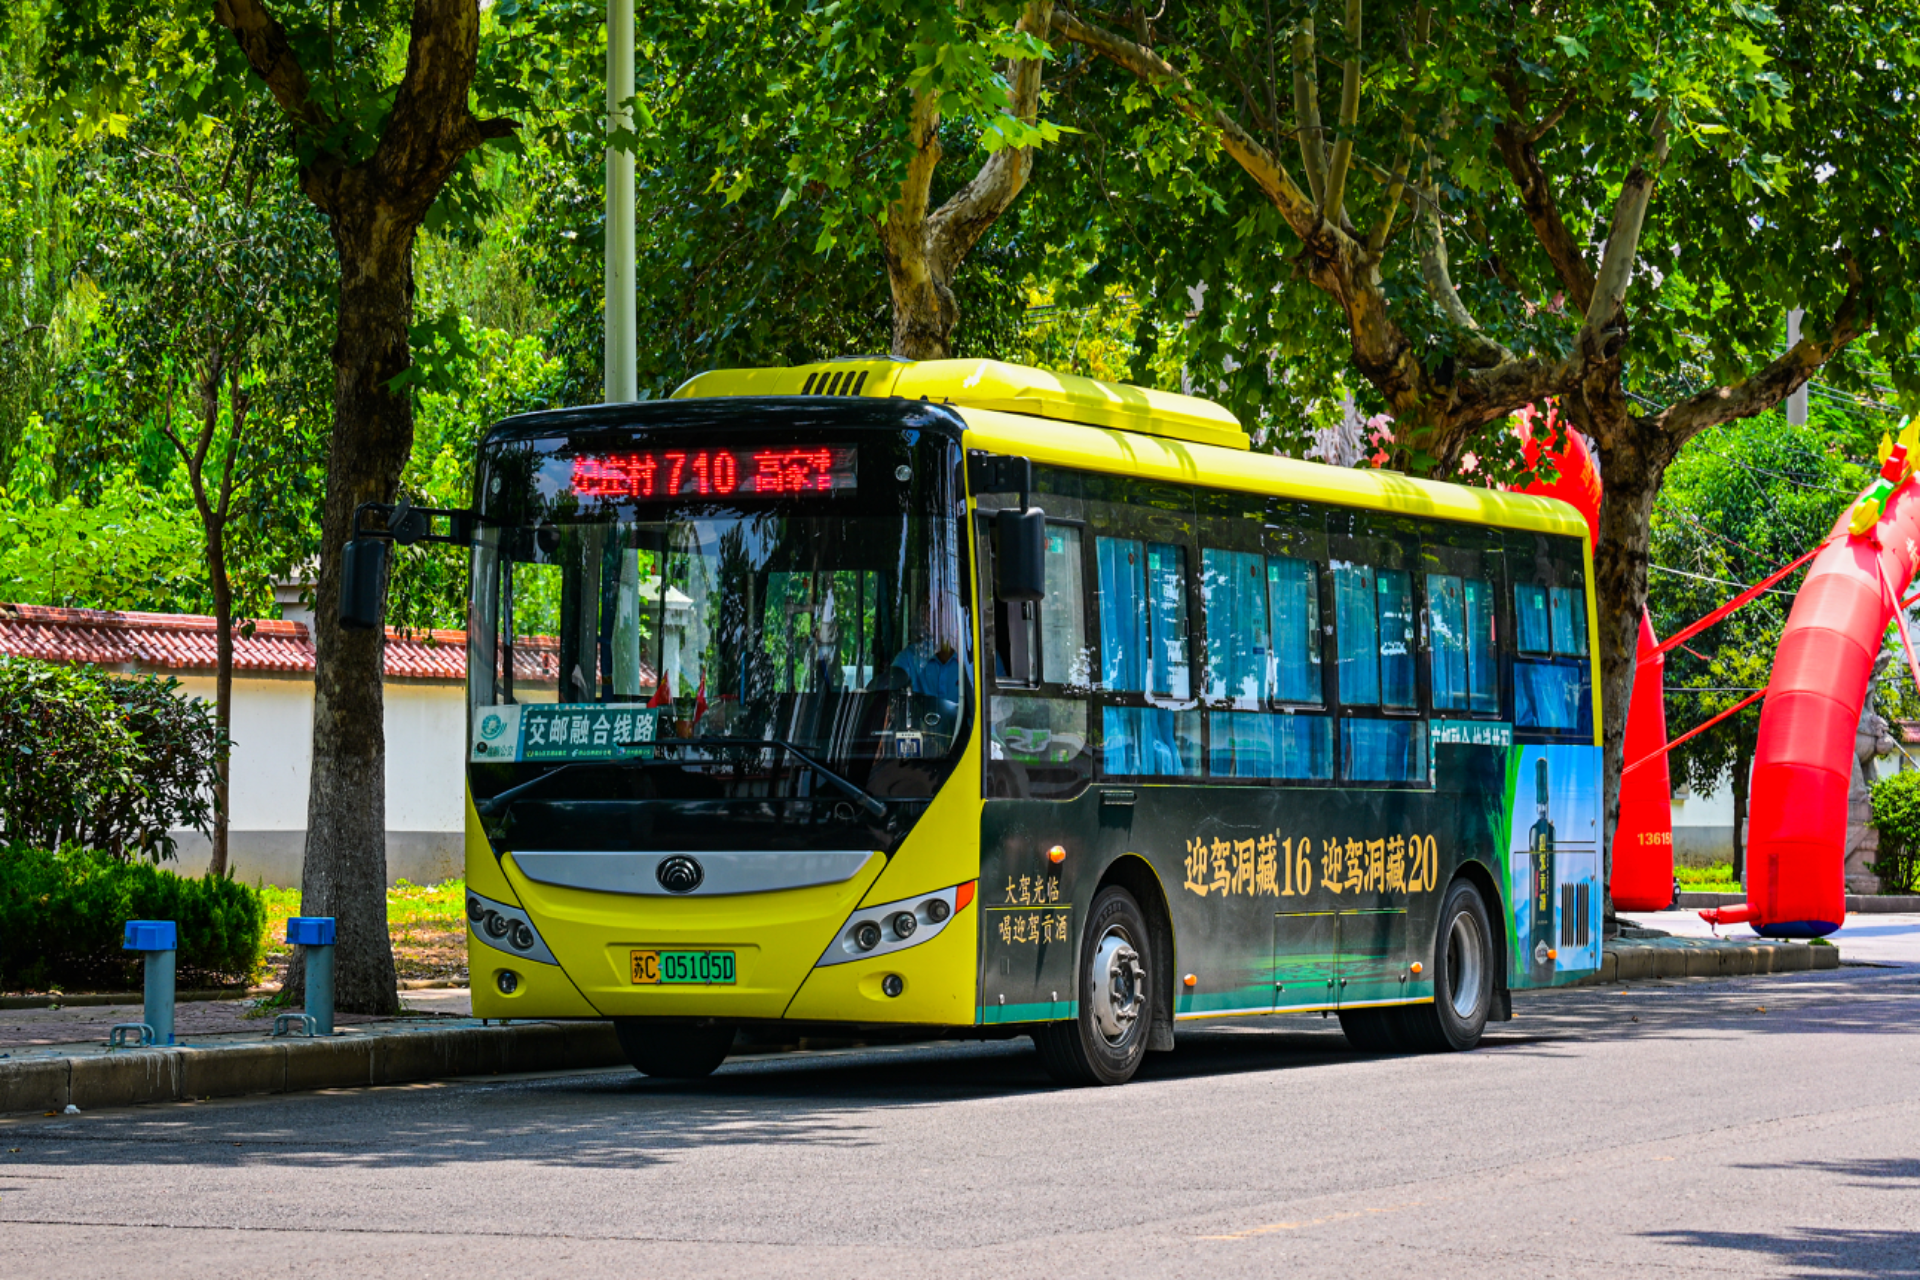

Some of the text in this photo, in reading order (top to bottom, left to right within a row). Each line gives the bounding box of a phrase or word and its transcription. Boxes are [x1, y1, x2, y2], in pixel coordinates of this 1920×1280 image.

[664, 450, 736, 495] 710
[528, 712, 654, 746] 交邮融合线路
[1638, 832, 1672, 846] 13615
[1183, 833, 1438, 897] 迎驾洞藏16 迎驾洞藏20
[1004, 873, 1059, 905] 大驾光临
[998, 912, 1067, 945] 喝迎驾贡酒
